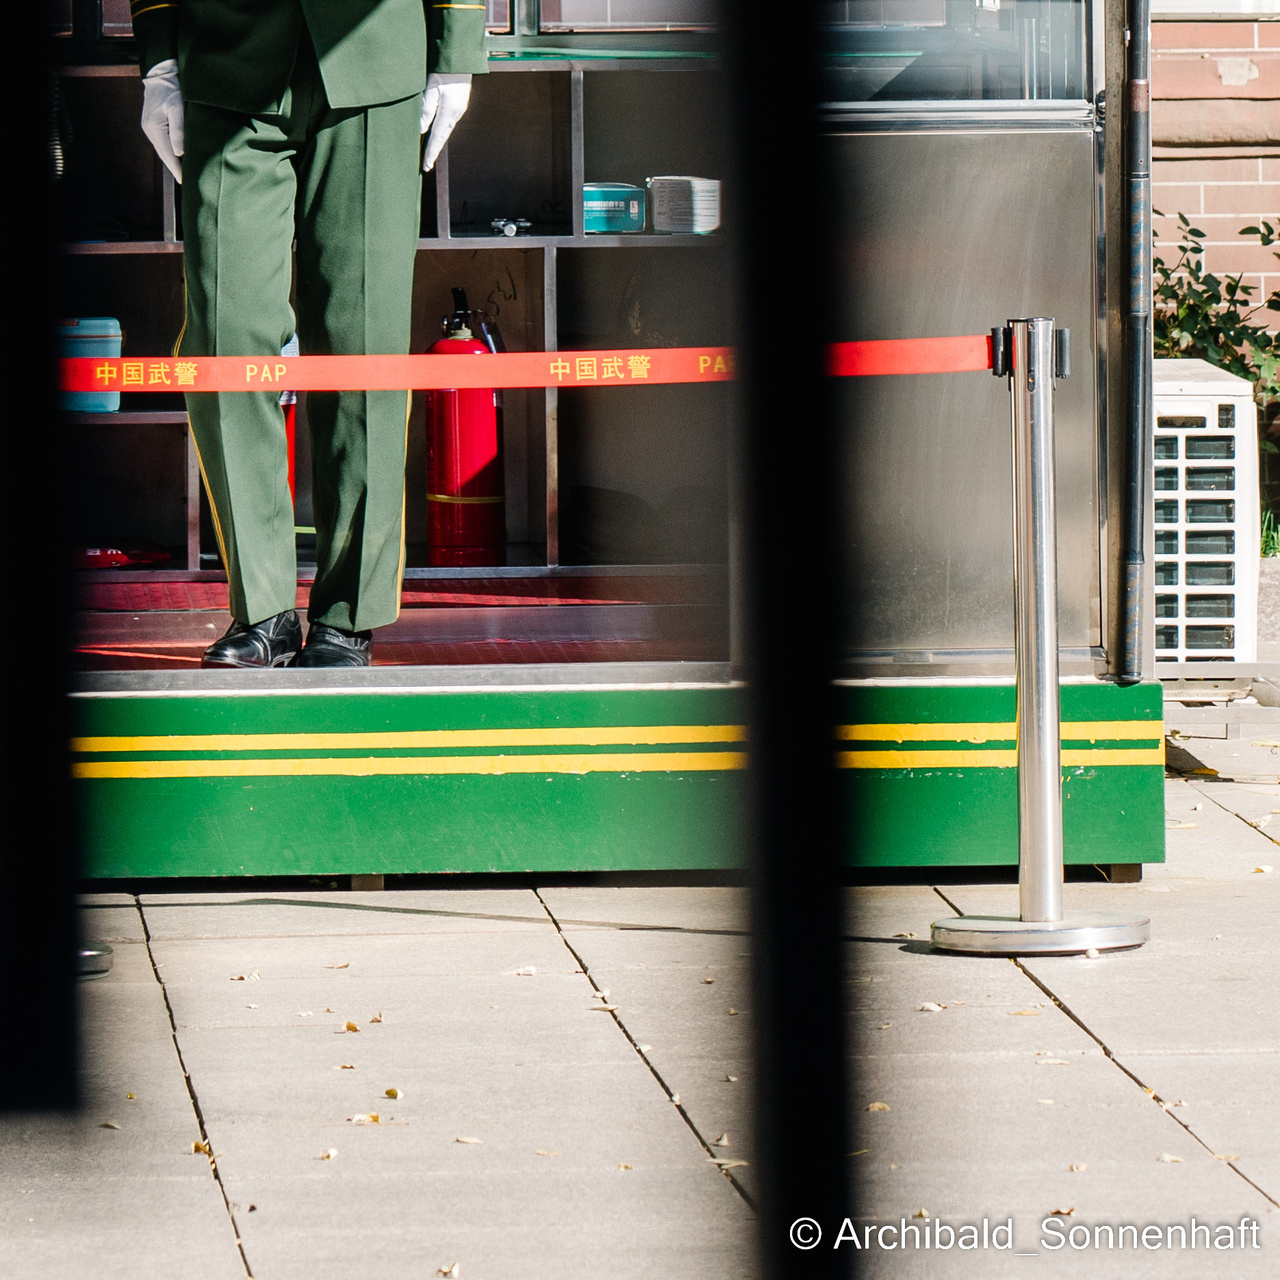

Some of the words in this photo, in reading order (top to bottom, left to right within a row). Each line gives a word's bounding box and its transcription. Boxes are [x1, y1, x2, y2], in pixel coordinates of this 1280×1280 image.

[96, 362, 198, 386] 中国武警
[245, 364, 287, 382] PAP
[549, 355, 651, 381] 中国武警
[699, 354, 732, 374] PA
